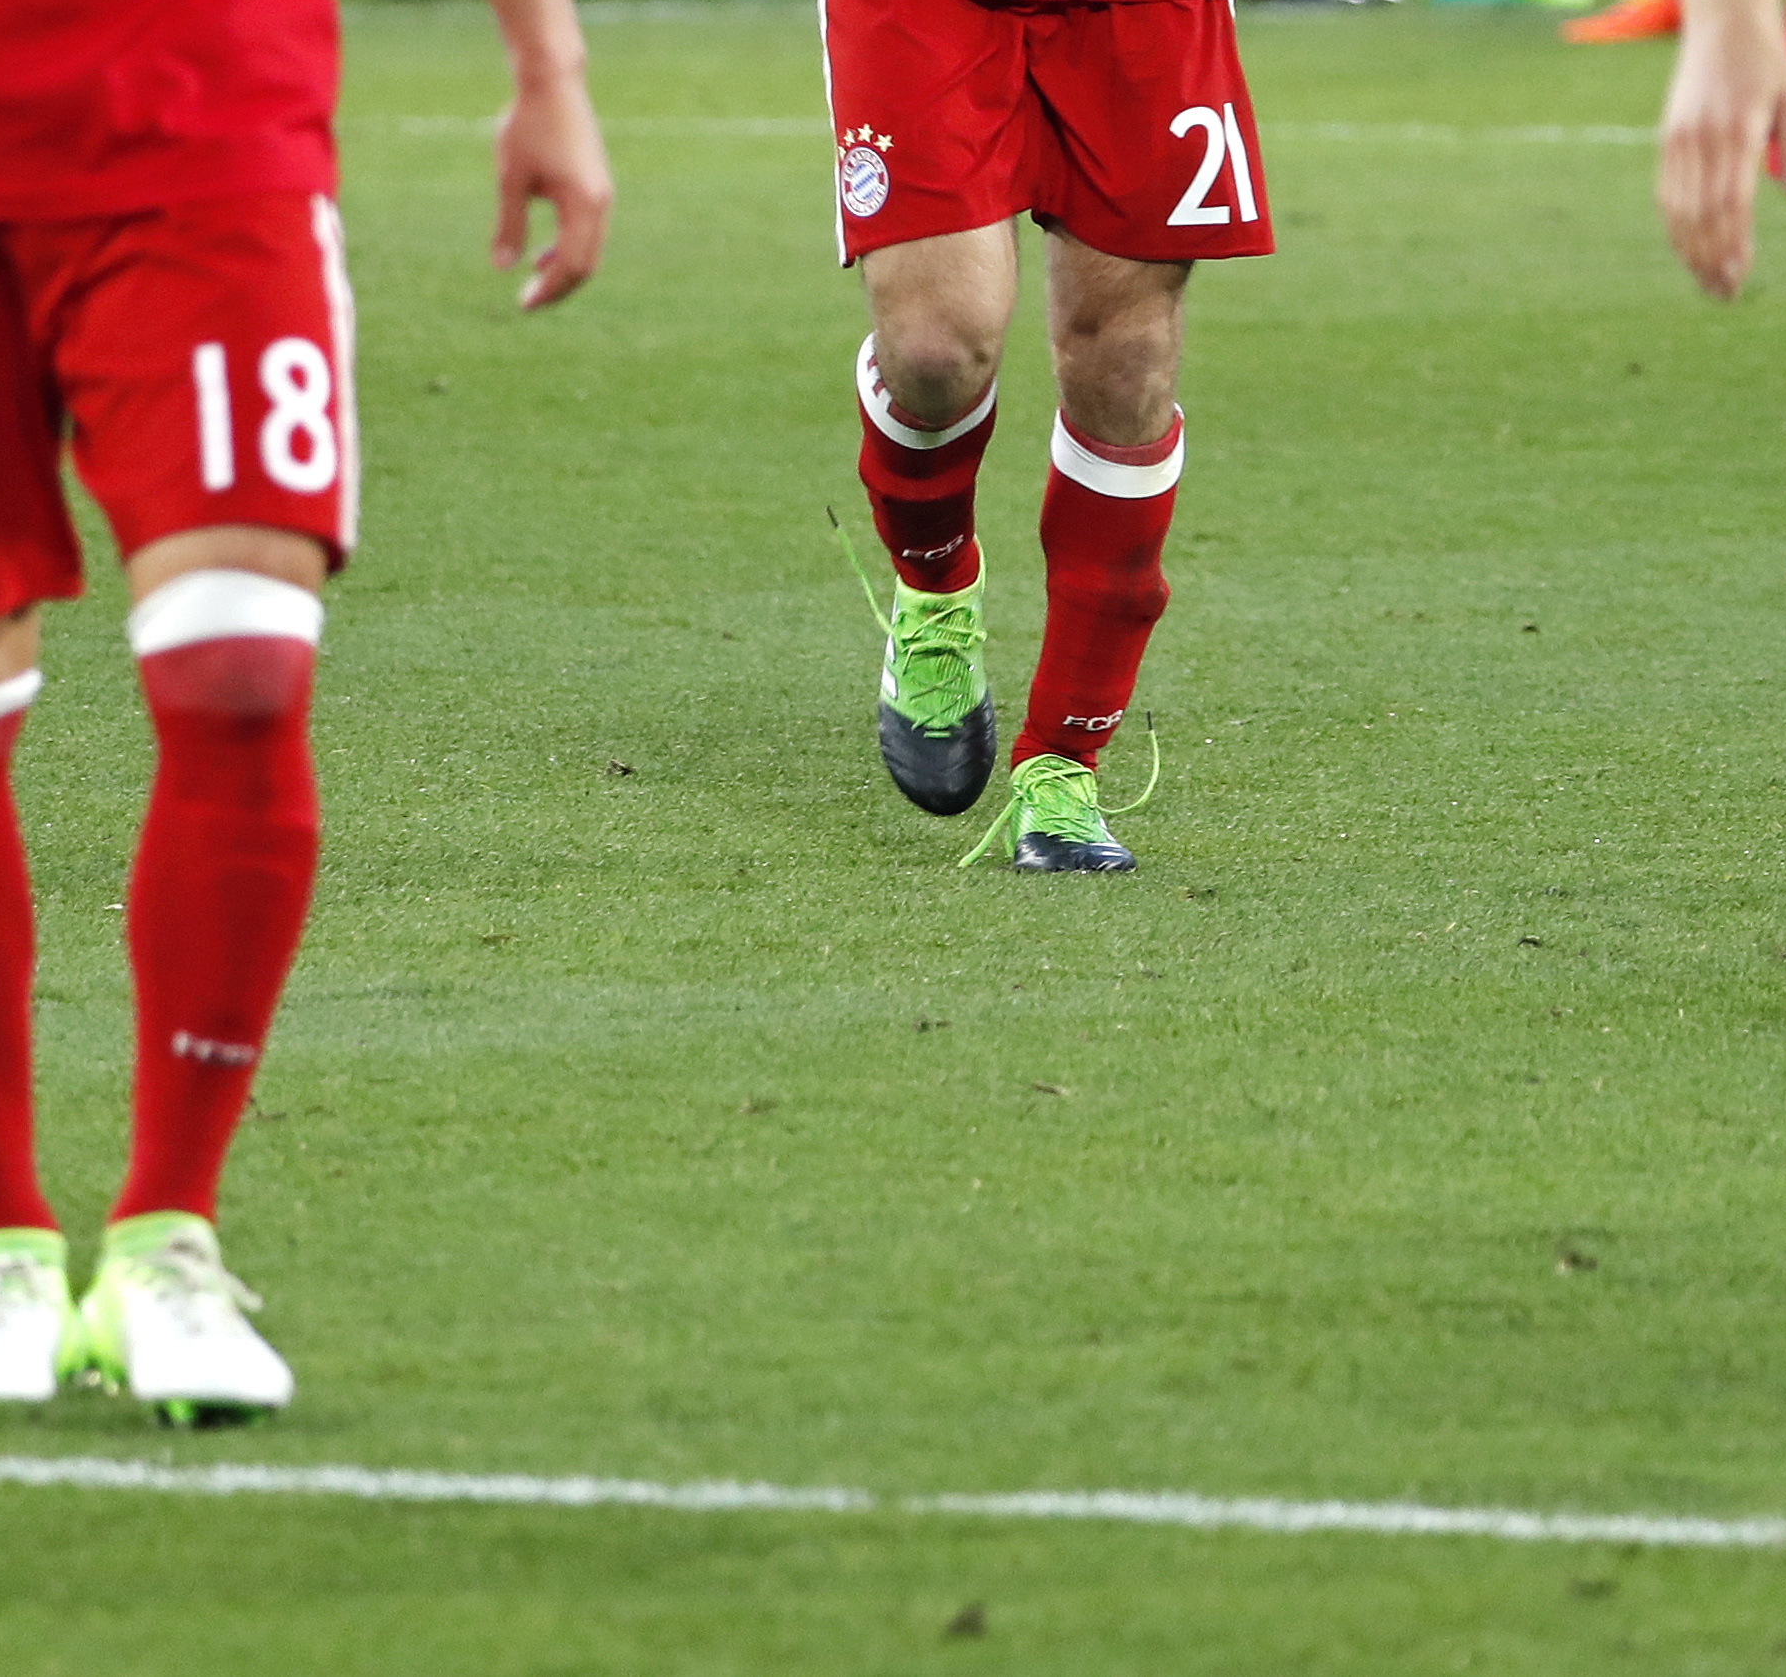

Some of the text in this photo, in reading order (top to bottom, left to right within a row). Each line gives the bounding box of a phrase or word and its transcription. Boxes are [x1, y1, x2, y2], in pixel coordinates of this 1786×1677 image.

[1166, 102, 1258, 225] 21
[191, 335, 338, 494] 18
[901, 533, 964, 561] FCB
[1062, 709, 1124, 732] FCB
